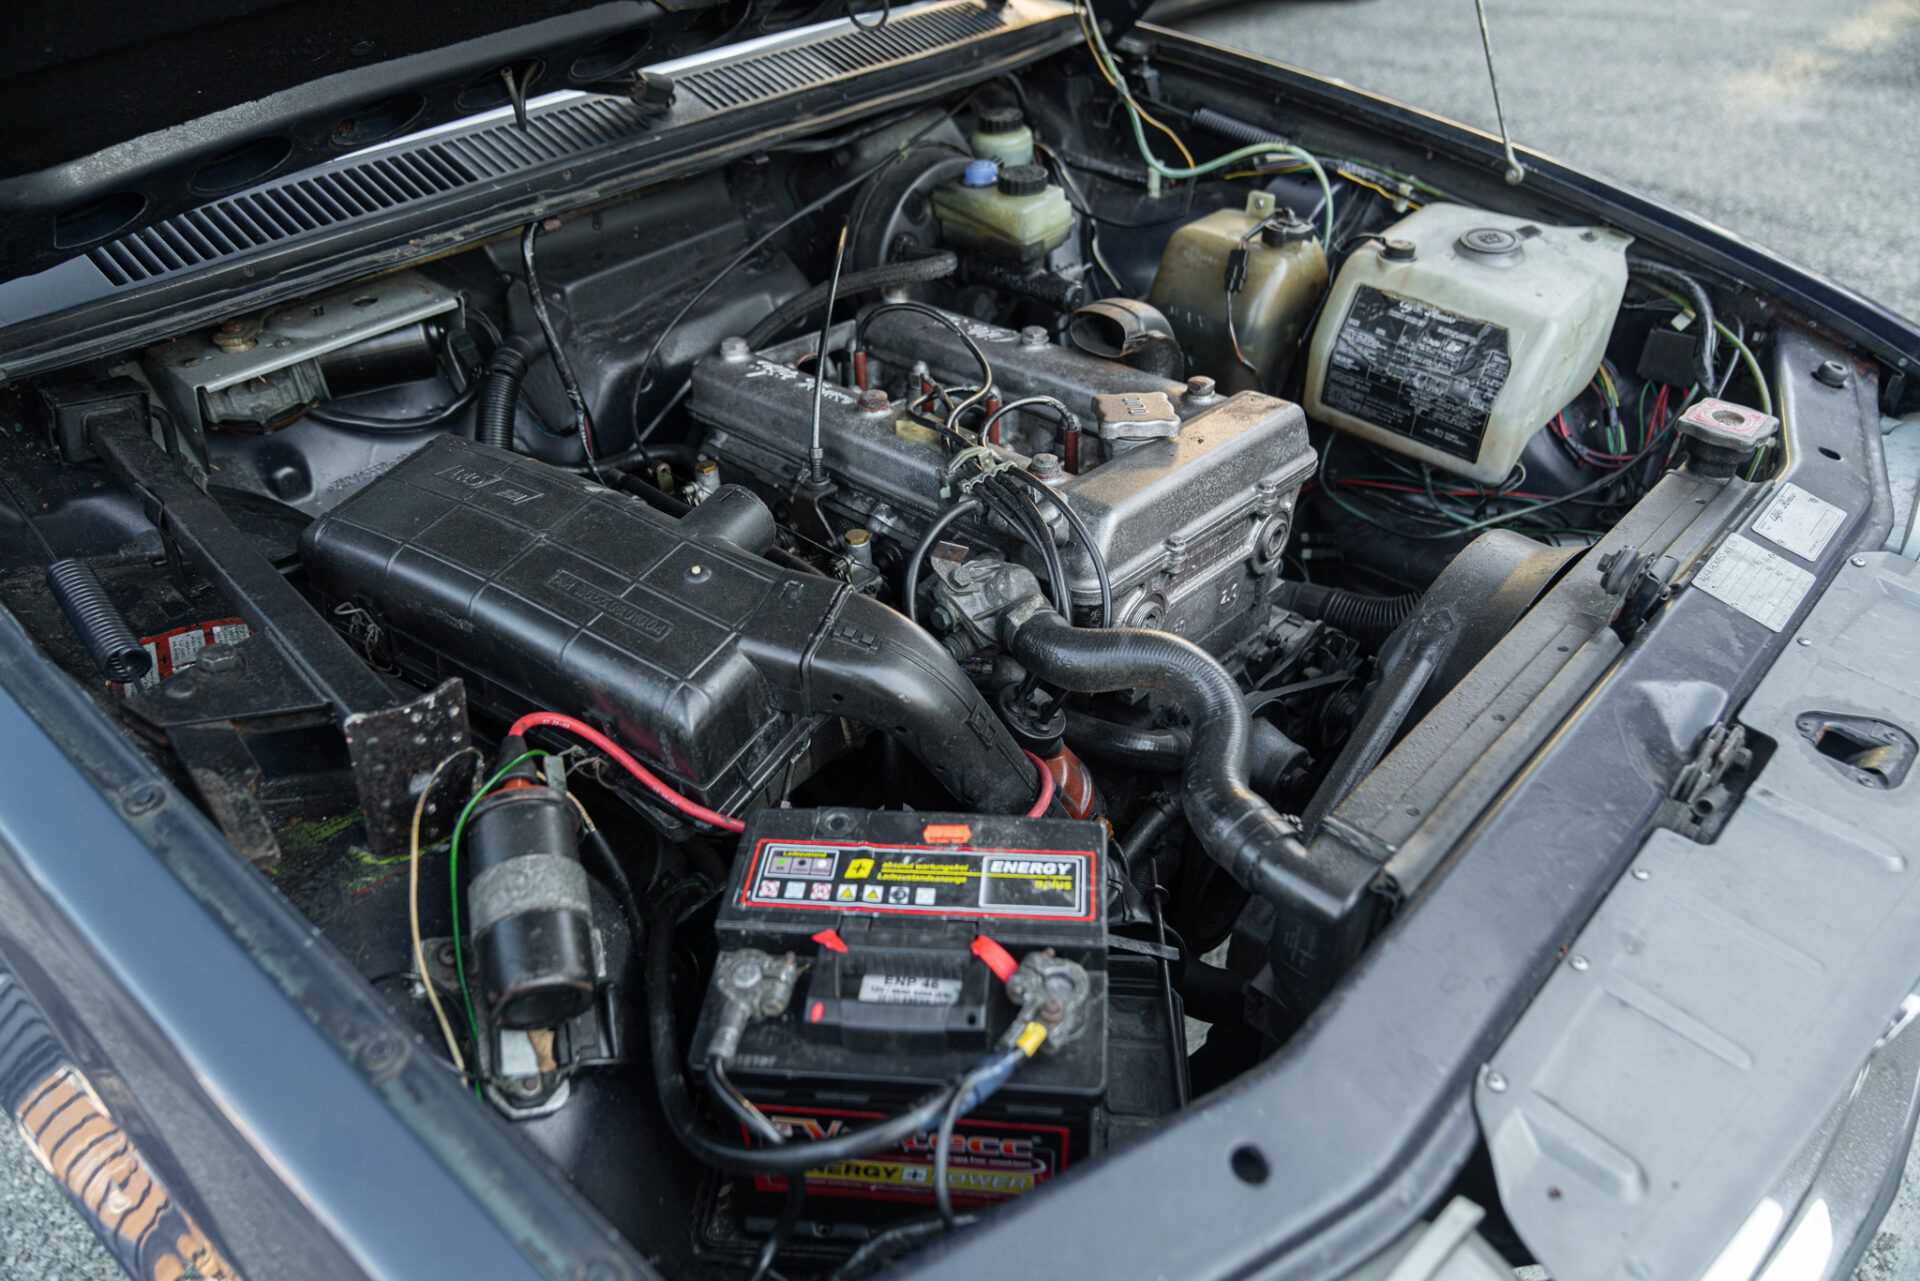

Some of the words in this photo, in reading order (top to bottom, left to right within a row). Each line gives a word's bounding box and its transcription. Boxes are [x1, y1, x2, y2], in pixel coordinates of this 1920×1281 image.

[1709, 552, 1727, 571] ROMEO
[990, 860, 1072, 875] ENERGY
[947, 1171, 1025, 1188] OWER
